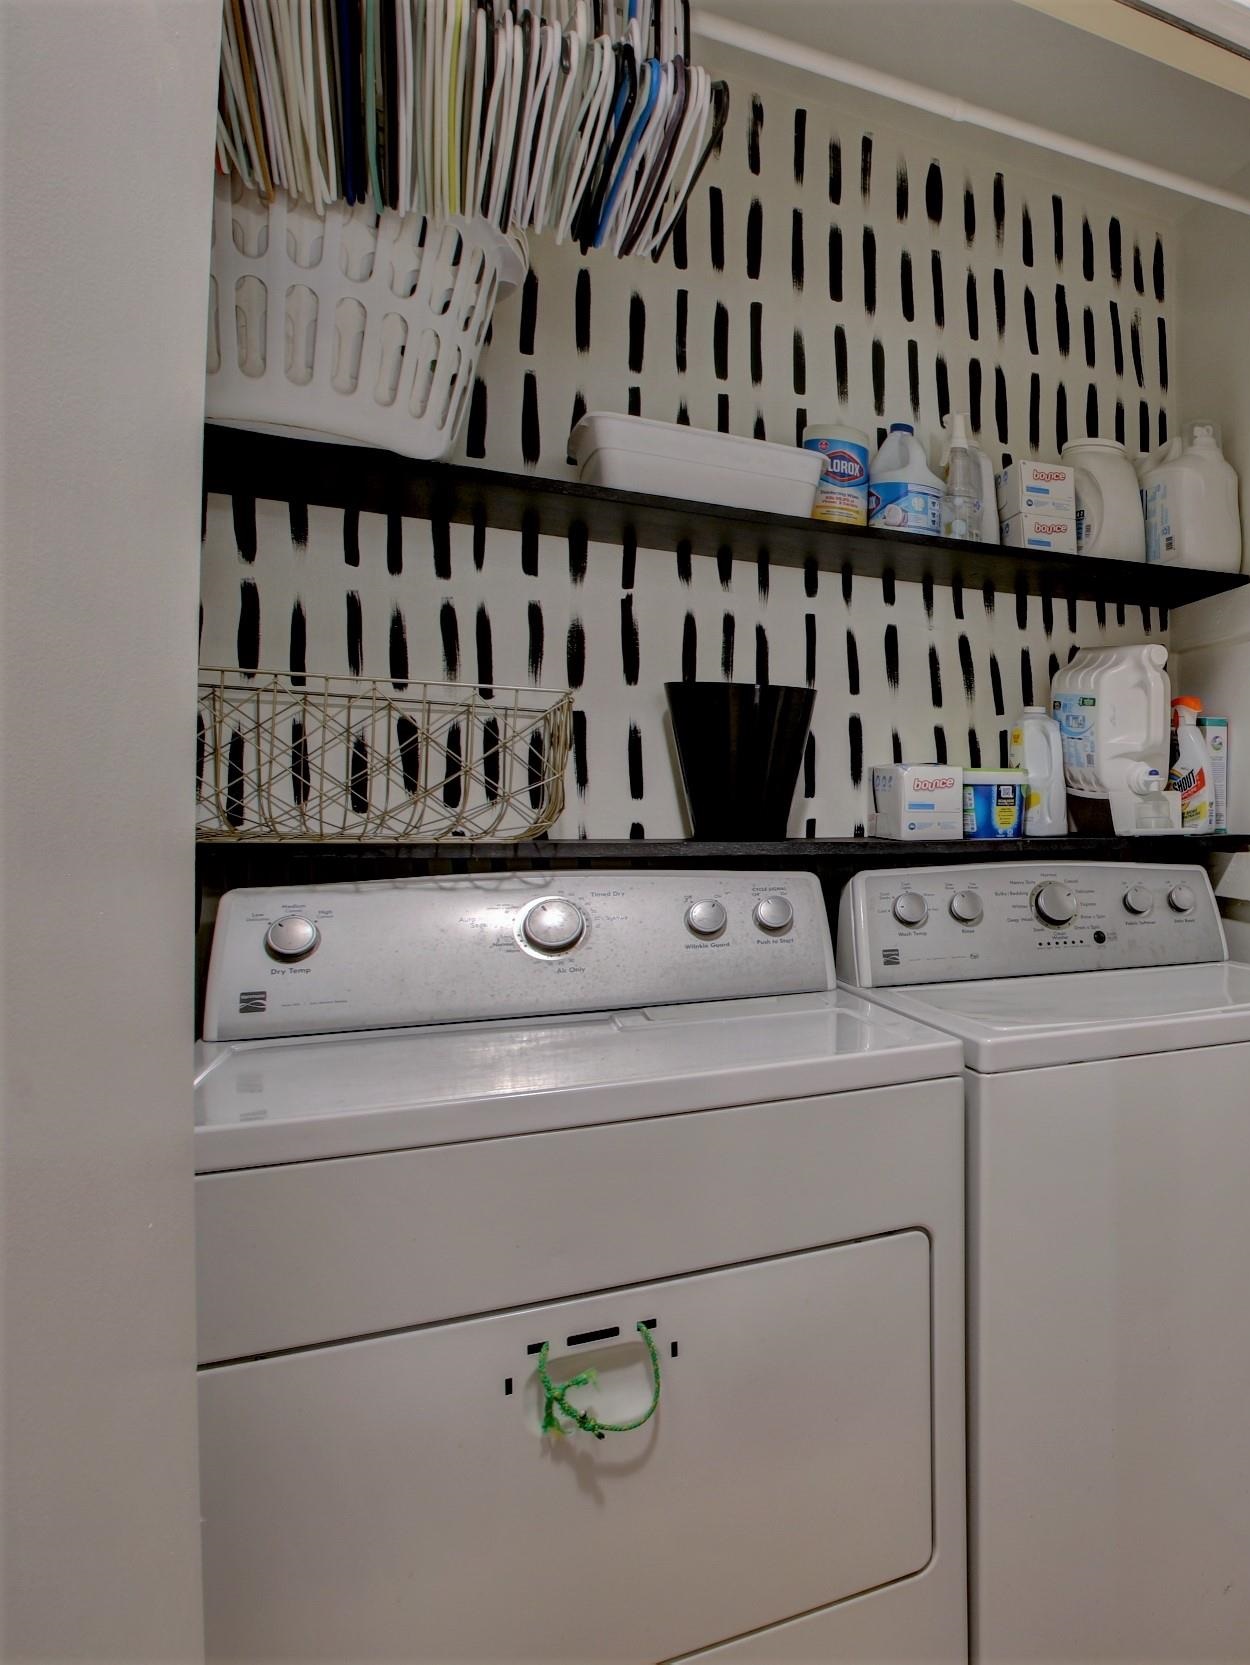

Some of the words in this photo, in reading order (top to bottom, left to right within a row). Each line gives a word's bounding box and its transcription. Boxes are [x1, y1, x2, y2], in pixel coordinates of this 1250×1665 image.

[828, 459, 860, 477] LOROX
[1032, 469, 1066, 482] bounce
[1034, 522, 1067, 535] bounce
[913, 777, 954, 792] bounce
[1173, 769, 1196, 792] SHOUT
[270, 968, 286, 976] Dry
[288, 967, 312, 975] Temp
[569, 966, 586, 974] Only
